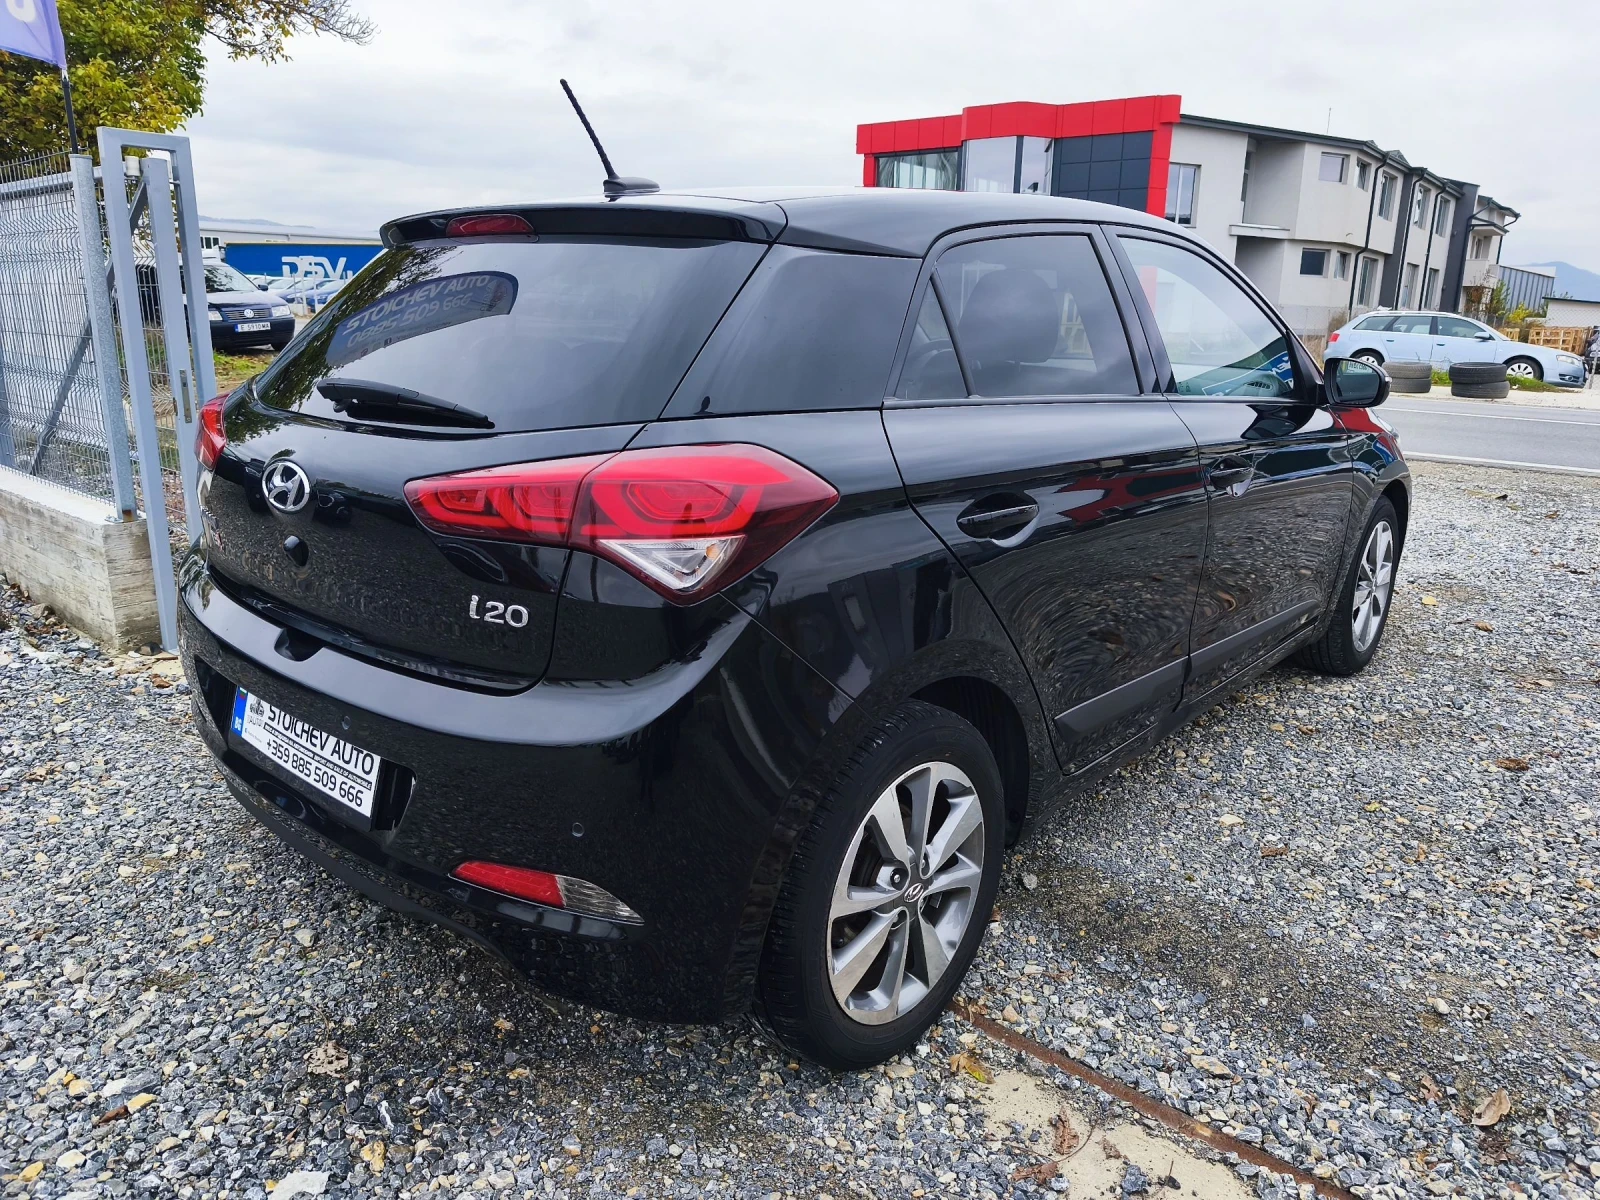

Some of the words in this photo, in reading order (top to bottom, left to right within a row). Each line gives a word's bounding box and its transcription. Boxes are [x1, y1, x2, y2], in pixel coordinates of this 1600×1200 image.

[342, 281, 446, 335] STOICHEV
[444, 275, 491, 293] AUTO
[347, 313, 401, 348] 0885
[399, 301, 440, 327] 509
[442, 293, 474, 310] 666
[234, 716, 242, 731] BG
[268, 705, 331, 752] STOICHEV
[330, 739, 374, 775] AUTO
[266, 738, 290, 764] +359
[291, 752, 312, 778] 885
[313, 765, 337, 792] 509
[339, 780, 364, 807] 666
